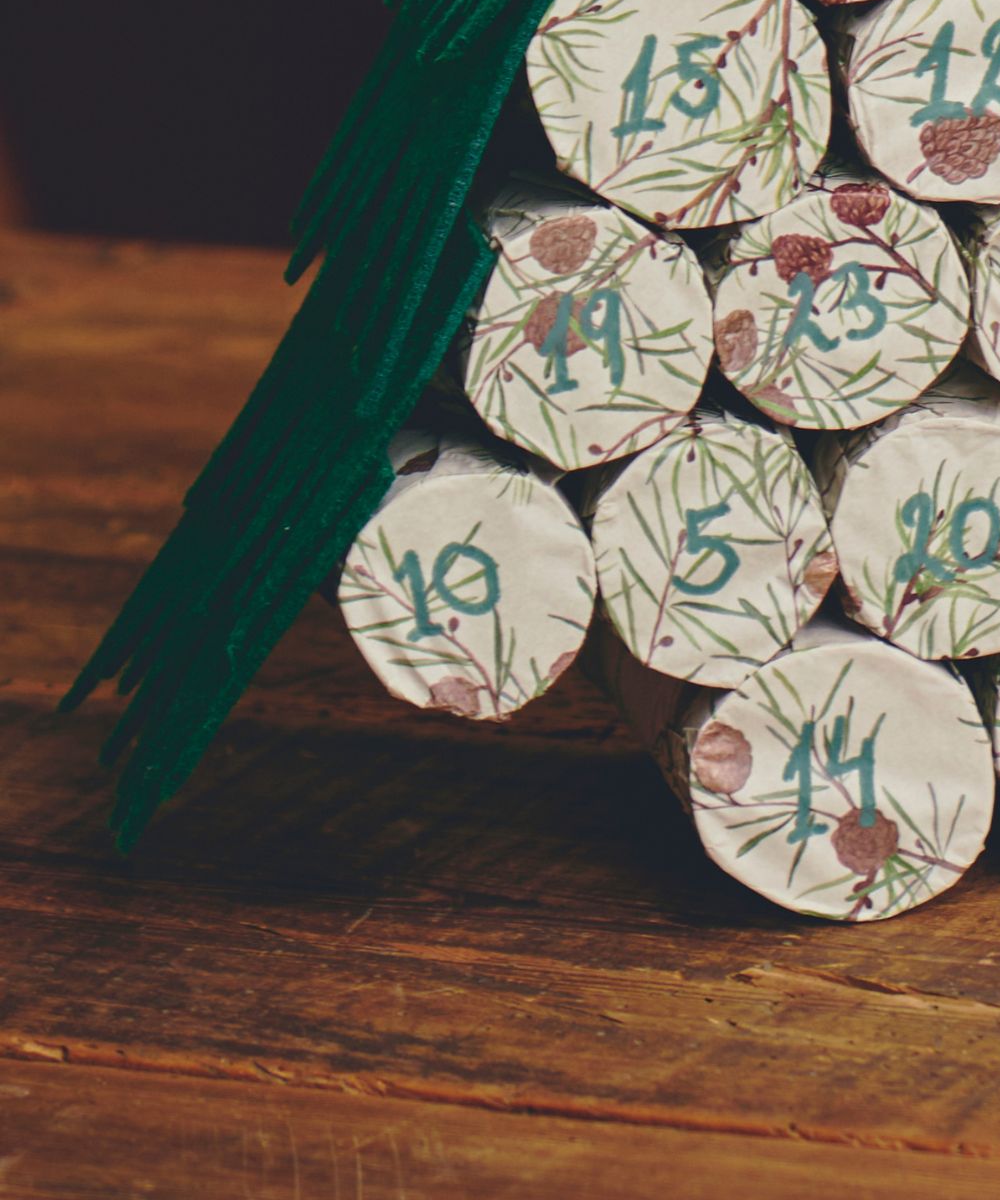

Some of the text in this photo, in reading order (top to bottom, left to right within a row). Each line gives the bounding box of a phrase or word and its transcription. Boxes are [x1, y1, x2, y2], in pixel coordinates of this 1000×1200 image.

[611, 35, 720, 137] 15
[539, 287, 621, 392] 19
[780, 262, 885, 352] 23
[394, 542, 500, 642] 10
[673, 503, 741, 595] 5
[783, 715, 874, 844] 14
